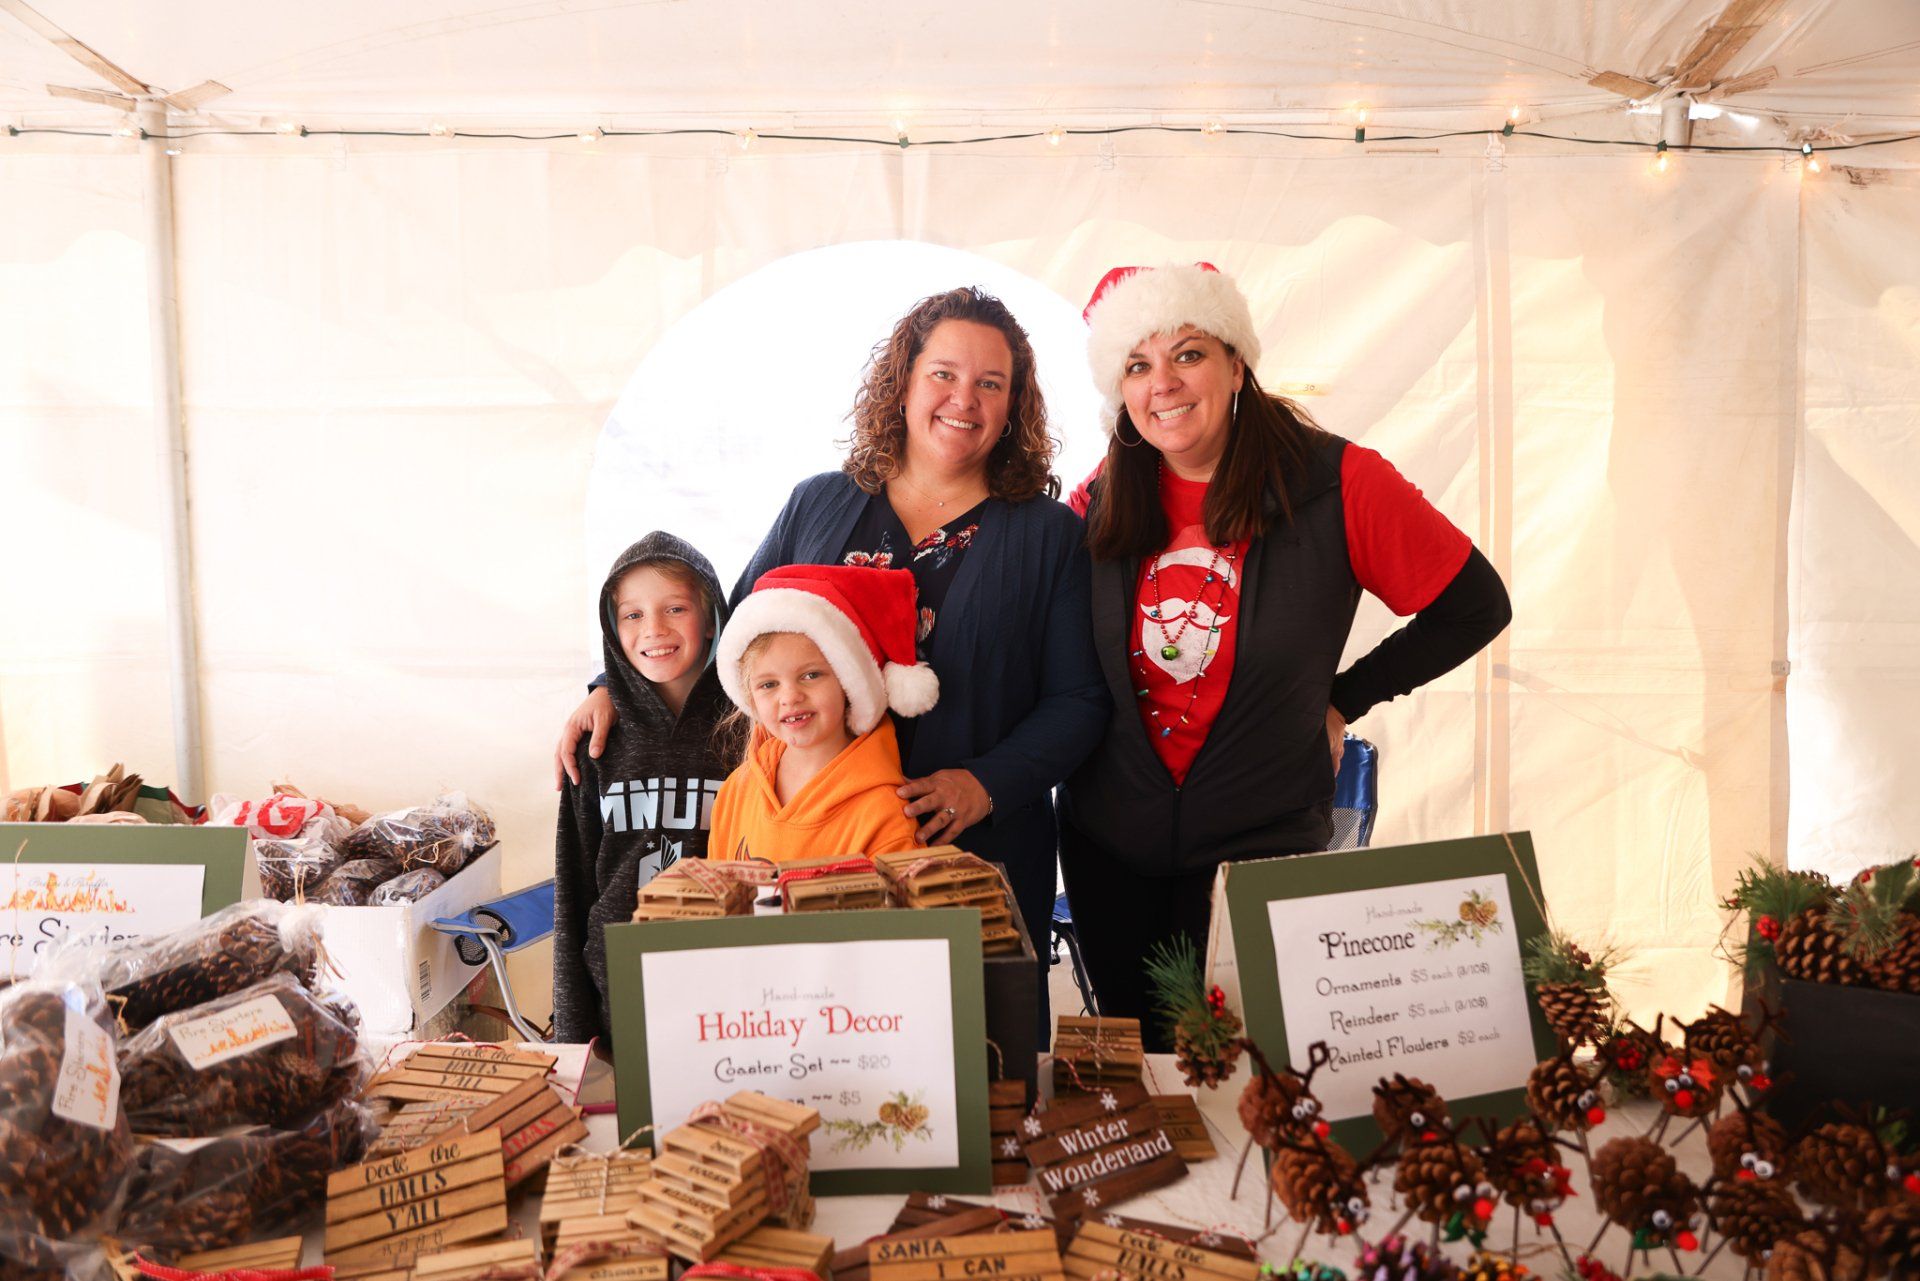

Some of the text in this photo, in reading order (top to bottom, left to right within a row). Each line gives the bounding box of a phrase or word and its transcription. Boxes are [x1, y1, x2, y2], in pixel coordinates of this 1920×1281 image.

[1319, 931, 1415, 959] Pinecone
[1315, 974, 1402, 996] Ornaments
[1410, 969, 1429, 984] $5
[1431, 967, 1453, 981] each
[761, 987, 836, 1006] Hand-made
[696, 1004, 903, 1047] Holiday Decor
[1330, 1006, 1400, 1035] Reindeer
[1407, 1003, 1426, 1020] $5
[1428, 999, 1450, 1015] each
[452, 1047, 484, 1060] Deck
[1327, 1026, 1501, 1072] Painted Flowers $2 each
[440, 1074, 483, 1089] Y'ALL
[444, 1060, 499, 1075] HALLS
[714, 1055, 783, 1083] Coaster
[789, 1053, 825, 1080] Set
[857, 1054, 892, 1071] $20
[840, 1090, 862, 1107] $5
[1058, 1118, 1129, 1156] Winter
[365, 1142, 461, 1184] Deck the
[1043, 1130, 1173, 1192] Wonderland
[379, 1169, 447, 1208] HALLS
[386, 1198, 442, 1230] Y'ALL
[1118, 1231, 1162, 1254] Deck
[964, 1257, 1007, 1276] CAN
